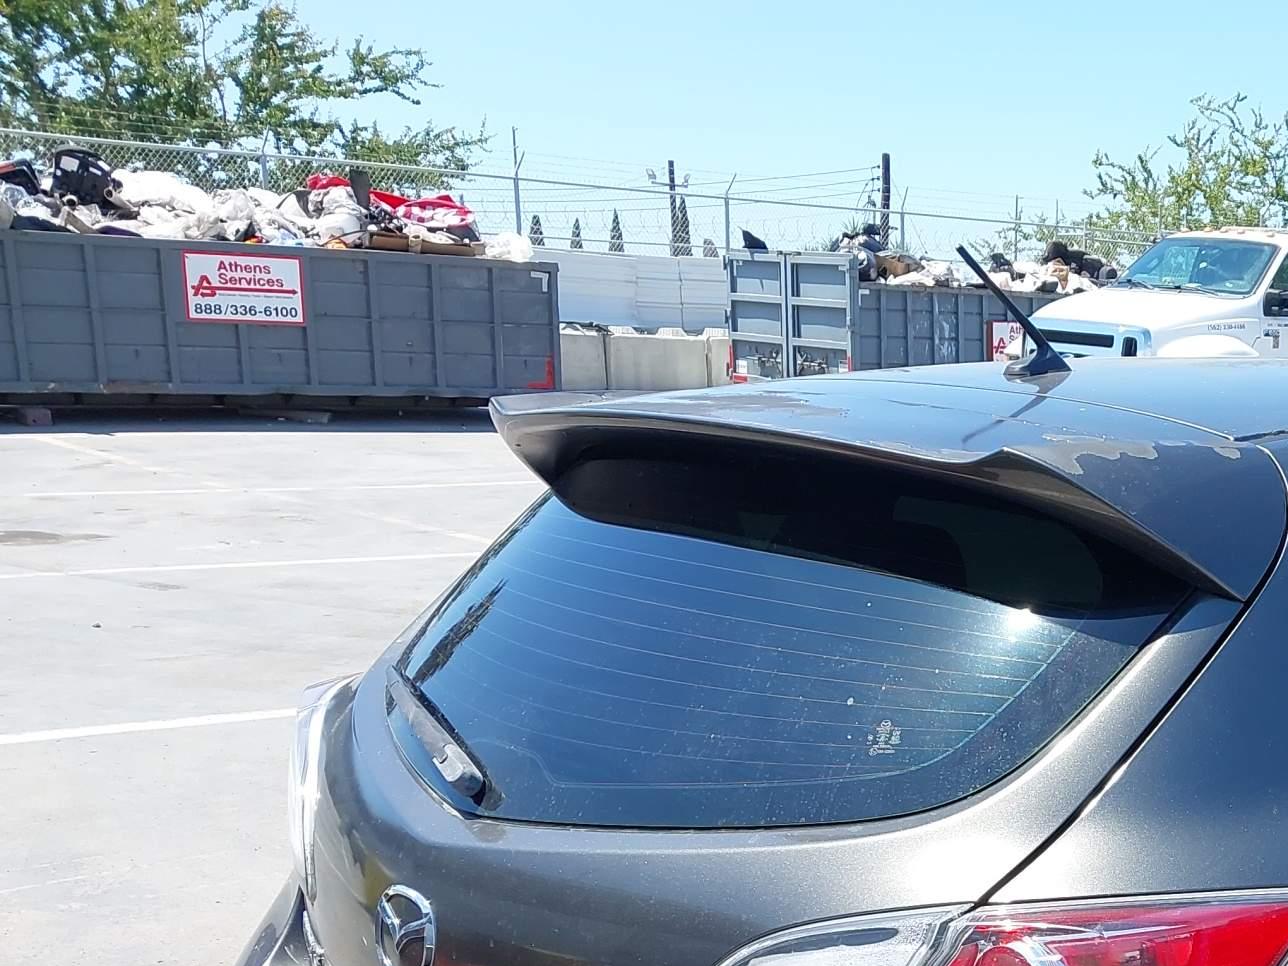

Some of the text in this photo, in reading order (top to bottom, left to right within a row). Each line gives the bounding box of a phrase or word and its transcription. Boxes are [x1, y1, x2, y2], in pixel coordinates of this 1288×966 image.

[217, 260, 271, 274] Athens
[217, 272, 284, 288] Services
[194, 302, 298, 318] 888/336-6100
[1009, 325, 1025, 335] Ath
